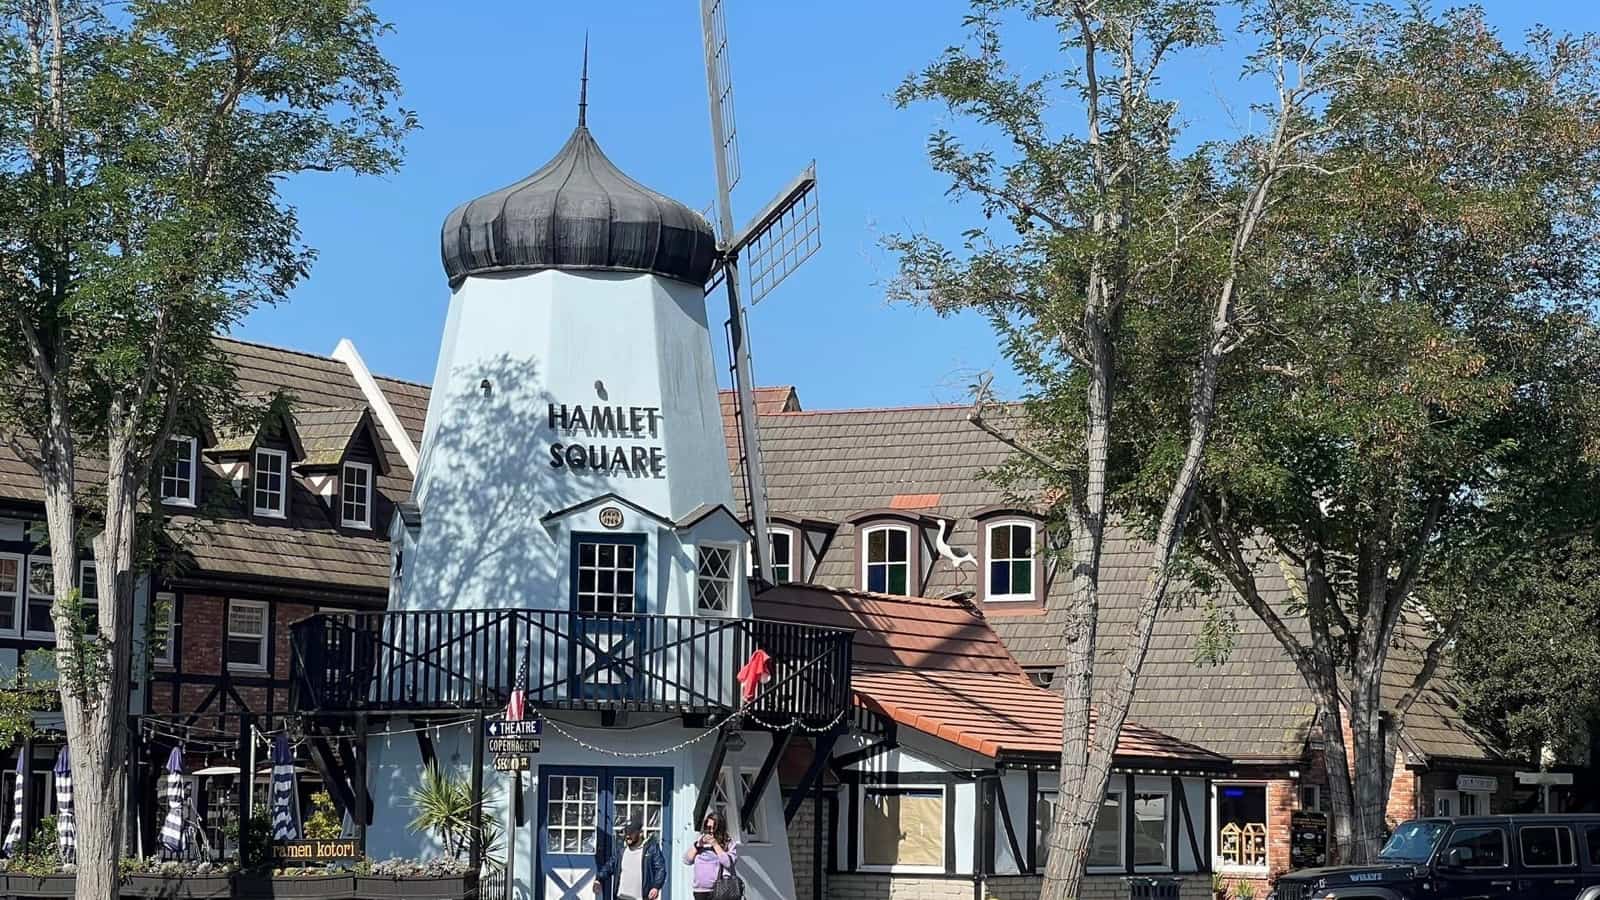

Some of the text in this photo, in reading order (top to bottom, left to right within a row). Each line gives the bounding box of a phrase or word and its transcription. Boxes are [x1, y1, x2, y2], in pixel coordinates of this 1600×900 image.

[548, 403, 660, 432] HAMLET
[549, 442, 663, 473] SQUARE
[500, 720, 537, 735] THEATRE
[489, 739, 533, 752] COPENHAGEN
[496, 757, 520, 770] SECD
[273, 841, 355, 858] ramen kotori
